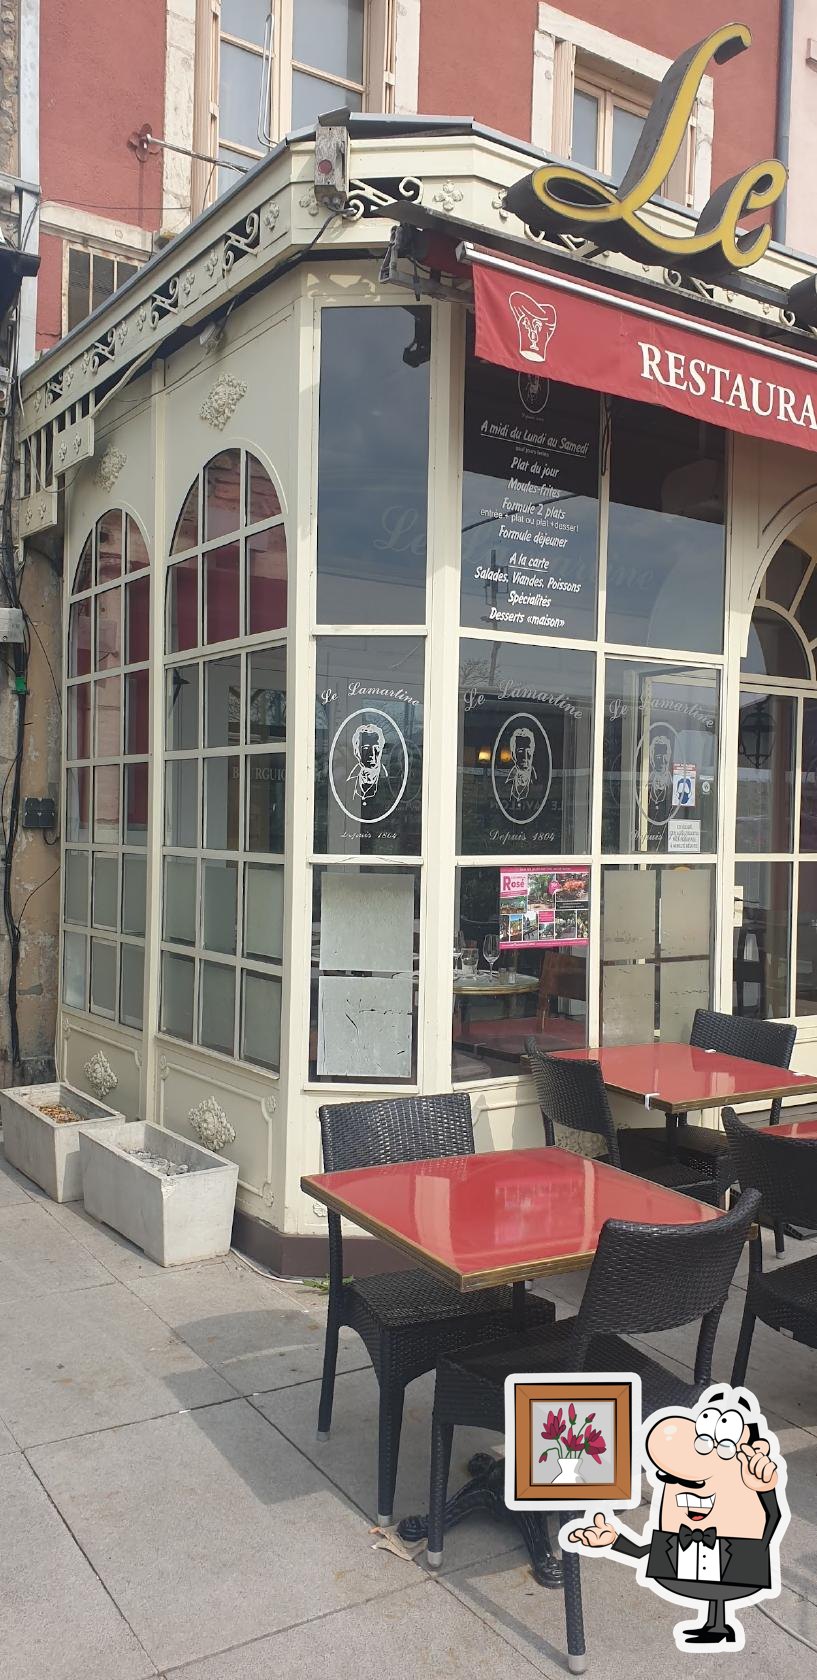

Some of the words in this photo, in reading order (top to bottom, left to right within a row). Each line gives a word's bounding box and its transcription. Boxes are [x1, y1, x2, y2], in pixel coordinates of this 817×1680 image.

[530, 22, 788, 268] Le
[637, 341, 817, 430] RESTAURA
[480, 420, 488, 432] A
[489, 422, 510, 436] midi
[510, 427, 522, 440] du
[523, 430, 547, 445] Lundi
[547, 437, 558, 447] au
[559, 437, 589, 454] Samedi
[511, 457, 530, 472] Plat
[530, 462, 542, 474] du
[541, 464, 560, 478] jour
[508, 477, 560, 498] Moules-frites
[480, 508, 503, 519] entrée
[511, 514, 524, 523] plat
[525, 517, 535, 525] ou
[502, 497, 536, 515] Formule
[537, 504, 544, 516] 2
[545, 506, 567, 520] plats
[499, 525, 532, 542] Formule
[533, 532, 568, 548] déjeuner
[509, 552, 517, 565] A
[518, 553, 527, 566] la
[528, 557, 550, 569] carte
[547, 577, 582, 593] Poissons
[508, 590, 551, 608] Spécialités
[489, 607, 525, 623] Desserts
[321, 689, 338, 705] Le
[347, 682, 420, 705] Lamartine
[463, 688, 486, 712] Le
[498, 680, 583, 719] Lamartine
[609, 699, 628, 721] Le
[639, 695, 714, 728] Lamartine
[489, 829, 526, 845] Depuis
[502, 875, 525, 891] Rosé
